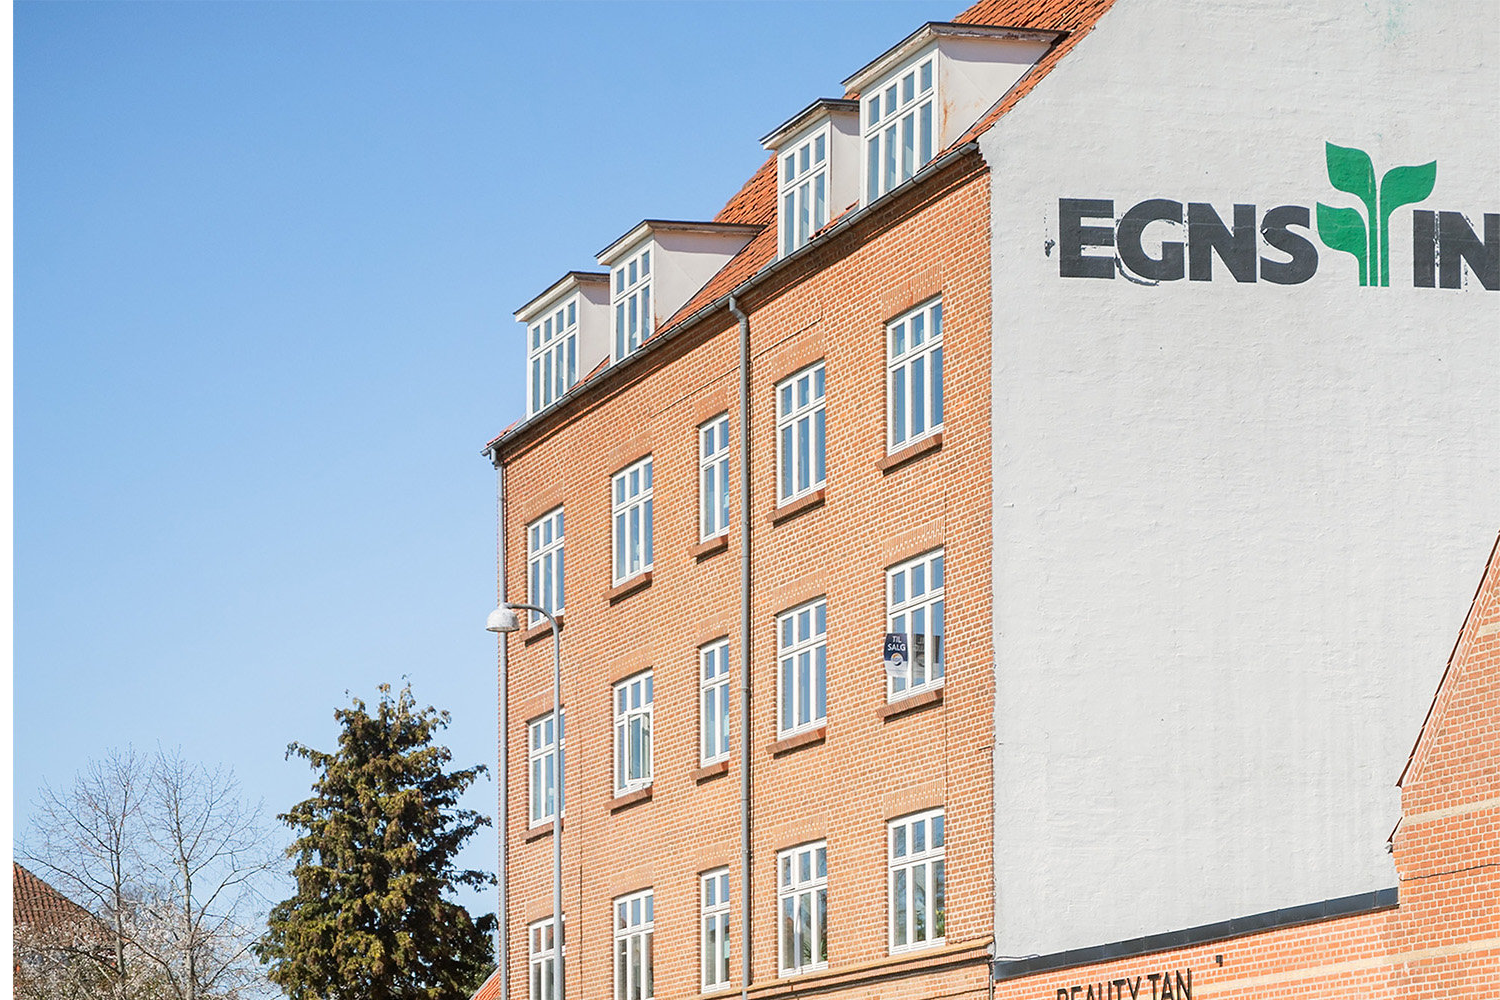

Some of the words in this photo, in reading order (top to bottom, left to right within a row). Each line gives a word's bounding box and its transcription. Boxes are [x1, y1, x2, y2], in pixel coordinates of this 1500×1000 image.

[1059, 198, 1319, 285] EGNS
[1413, 209, 1500, 292] IN
[892, 635, 902, 643] TIL
[887, 643, 906, 651] SALG
